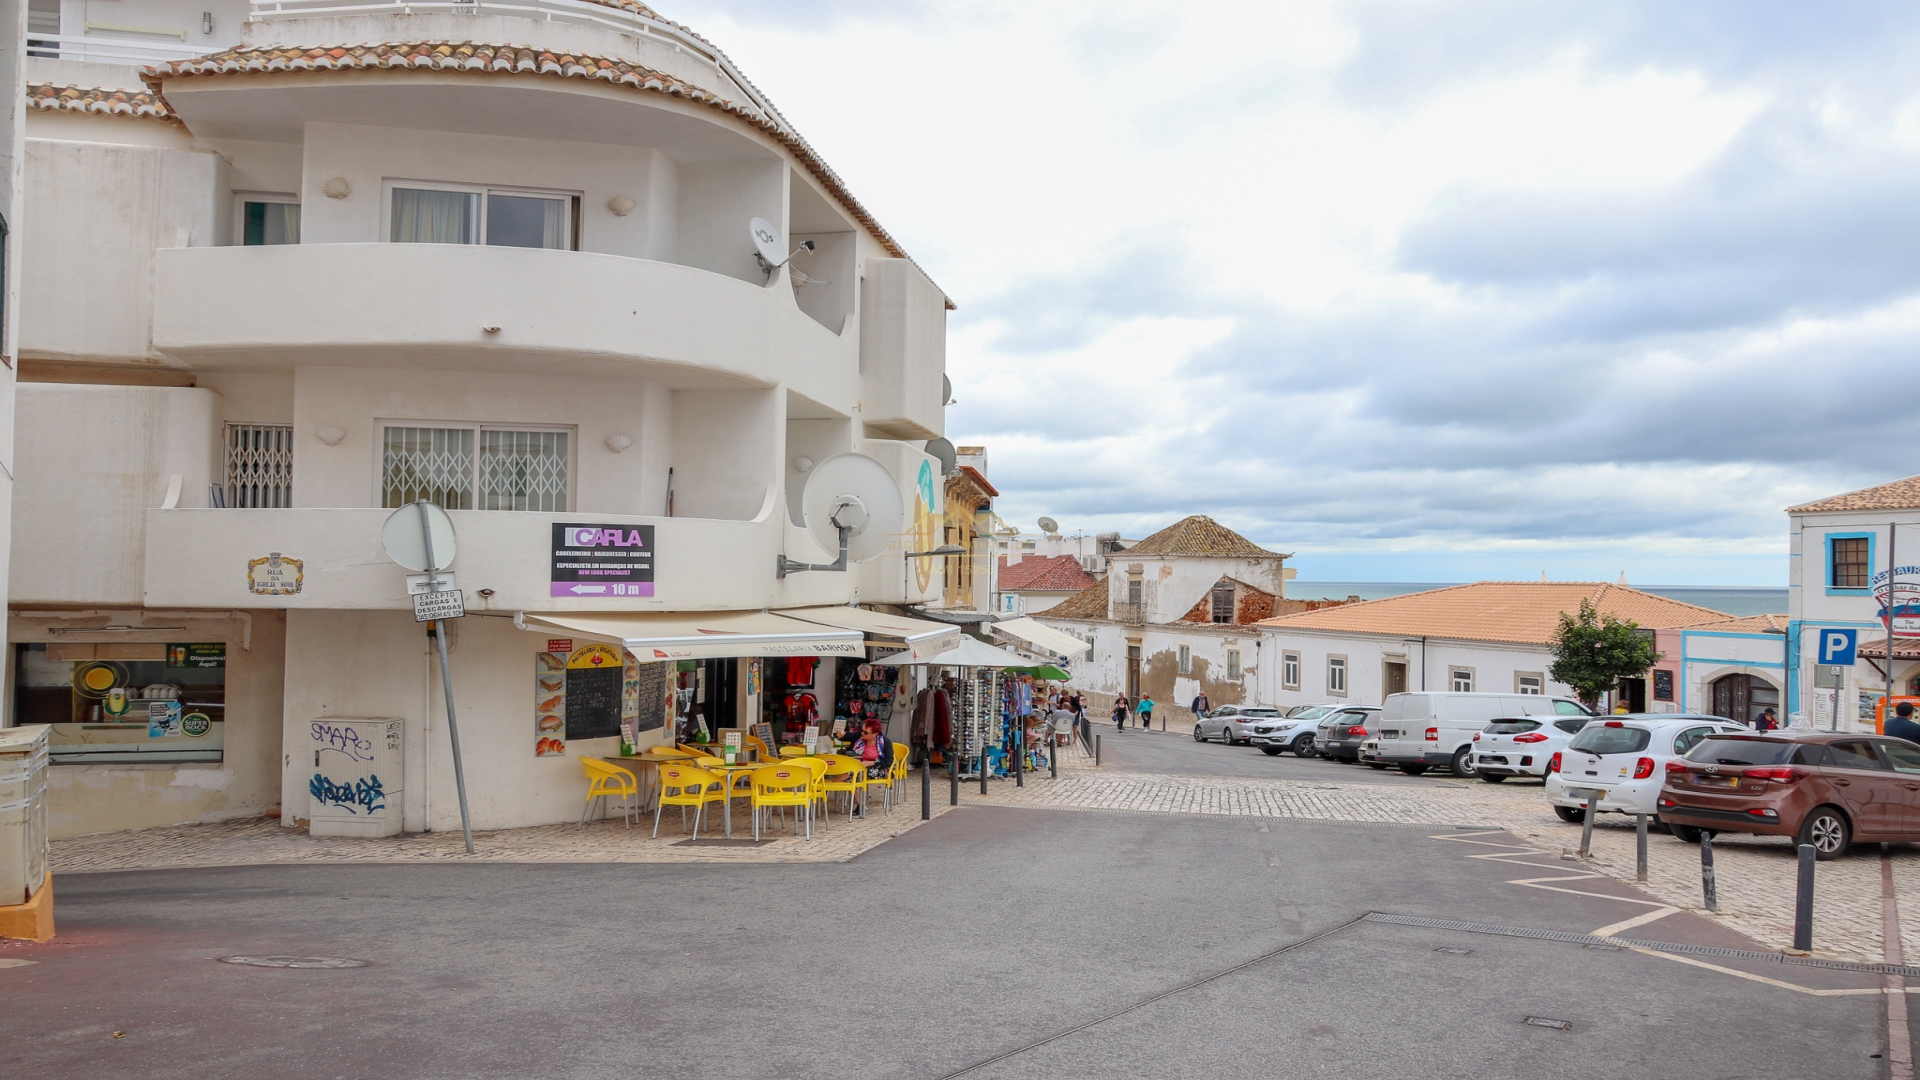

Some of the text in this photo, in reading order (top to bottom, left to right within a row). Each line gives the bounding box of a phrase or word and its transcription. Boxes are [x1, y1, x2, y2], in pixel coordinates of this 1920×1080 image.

[575, 528, 643, 547] CARLA
[612, 583, 639, 595] 10 m
[420, 592, 455, 601] EXCEPTO
[418, 604, 462, 614] DESCARGAS
[813, 644, 856, 652] BARHON
[1825, 633, 1849, 661] P
